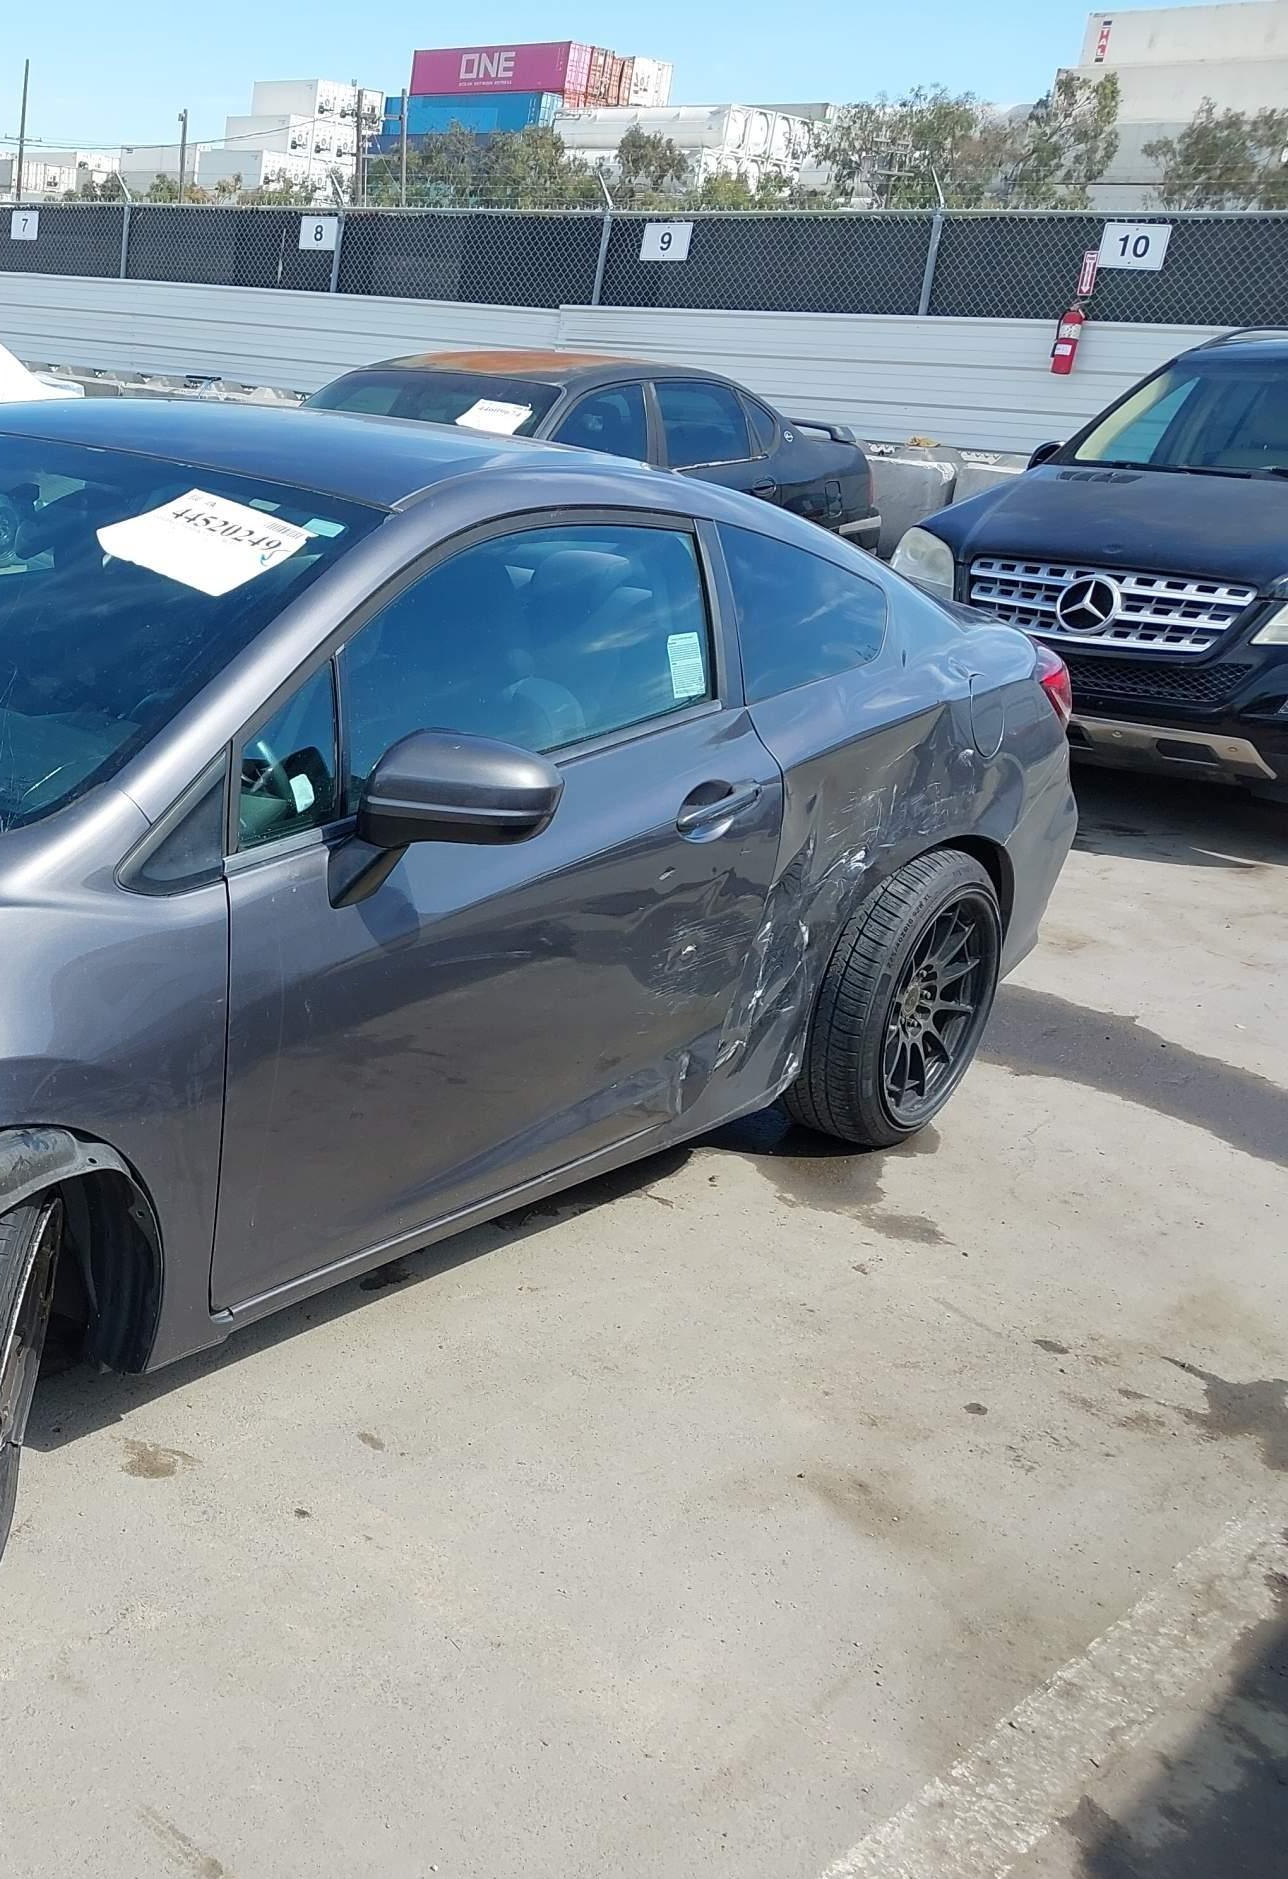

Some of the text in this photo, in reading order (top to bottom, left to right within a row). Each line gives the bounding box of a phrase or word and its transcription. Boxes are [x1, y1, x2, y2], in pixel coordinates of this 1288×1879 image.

[459, 51, 516, 79] ONE
[21, 218, 29, 232] 7
[314, 225, 323, 241] 8
[660, 232, 672, 251] 9
[1118, 234, 1150, 258] 10
[172, 508, 282, 551] 44520249
